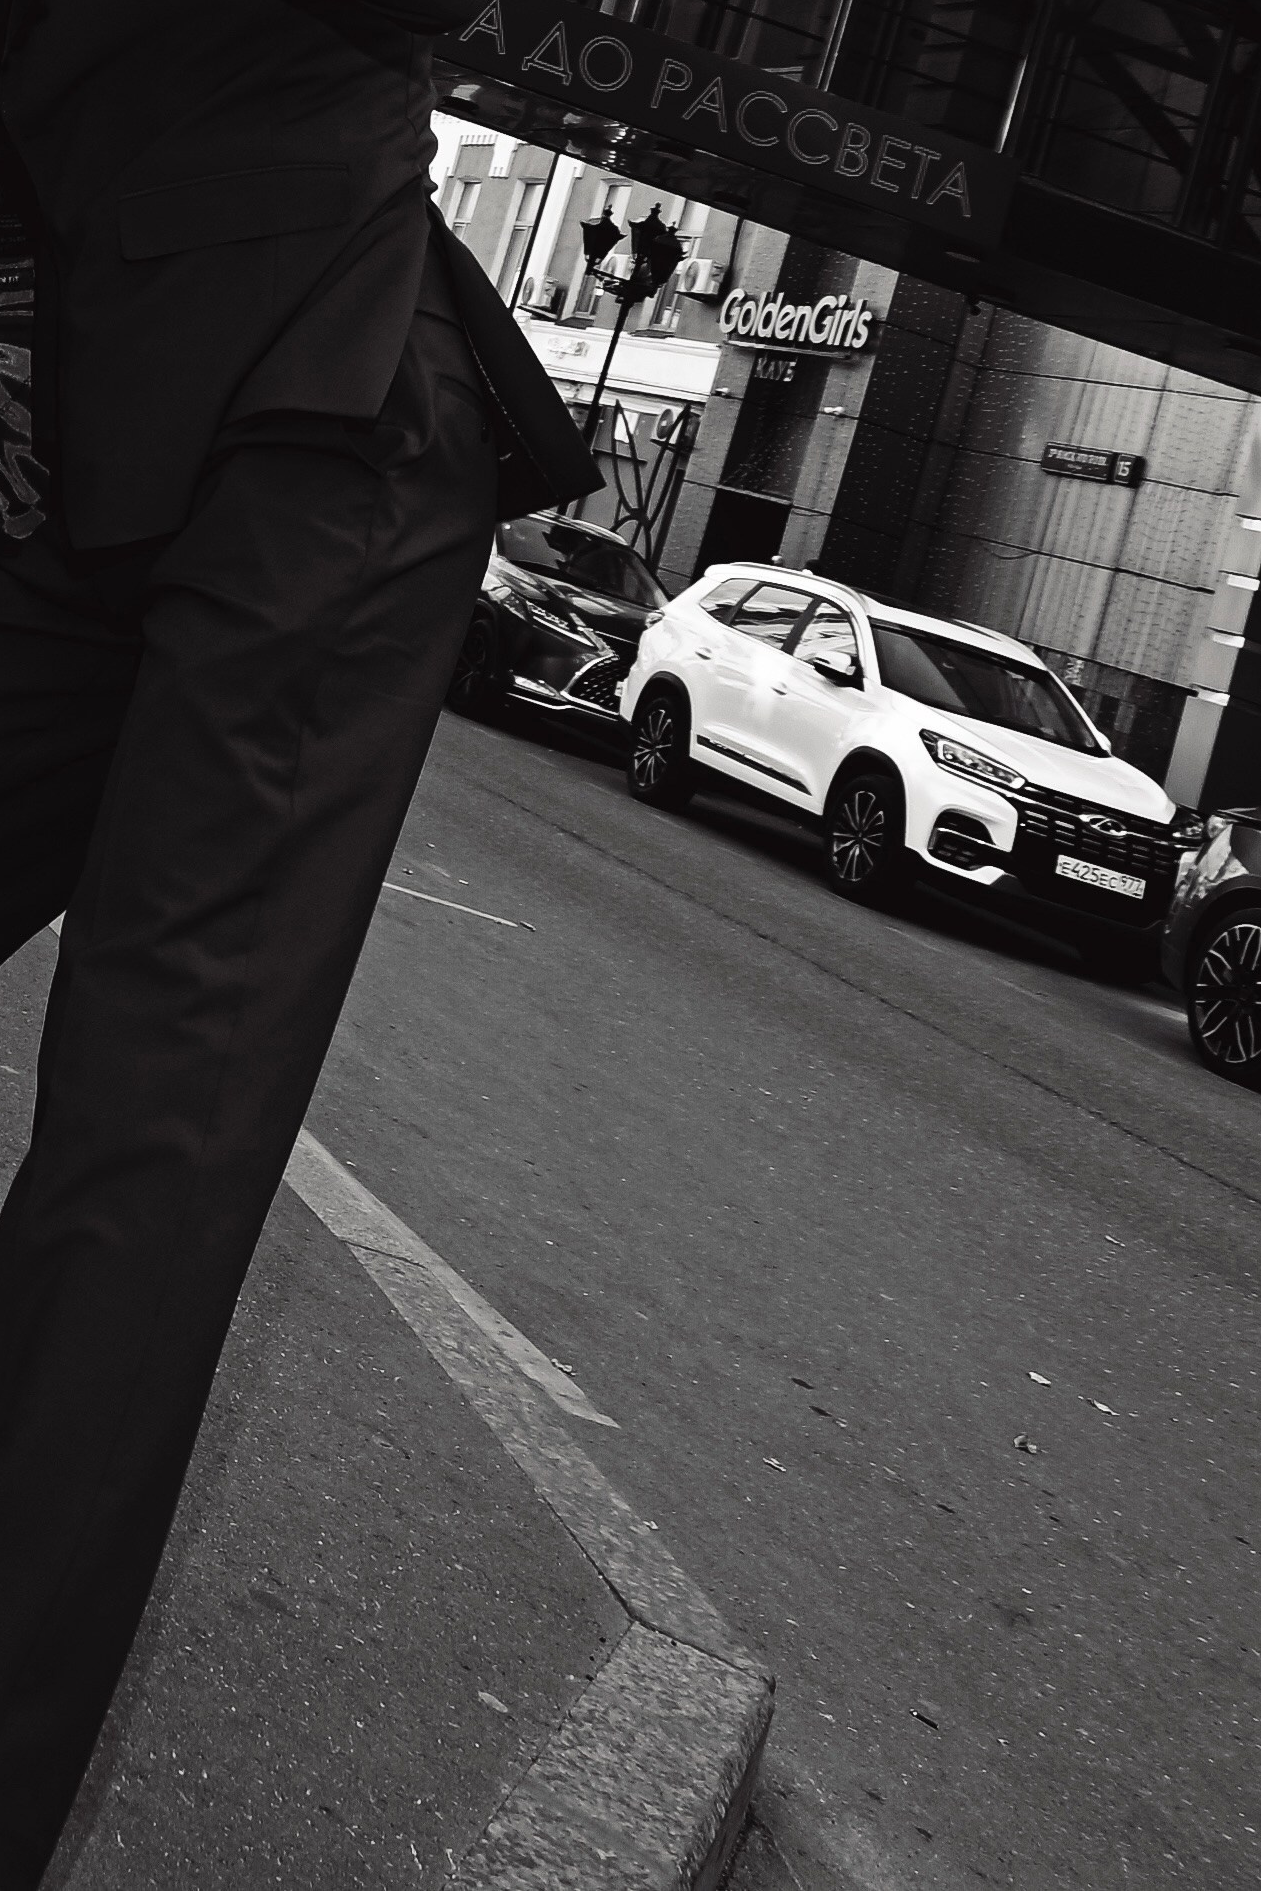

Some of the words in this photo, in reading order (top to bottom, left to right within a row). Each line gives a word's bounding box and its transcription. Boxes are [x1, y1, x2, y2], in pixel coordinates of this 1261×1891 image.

[521, 21, 633, 92] ДО
[650, 58, 972, 218] РАССВЕТА
[719, 288, 872, 349] GoldenGirls
